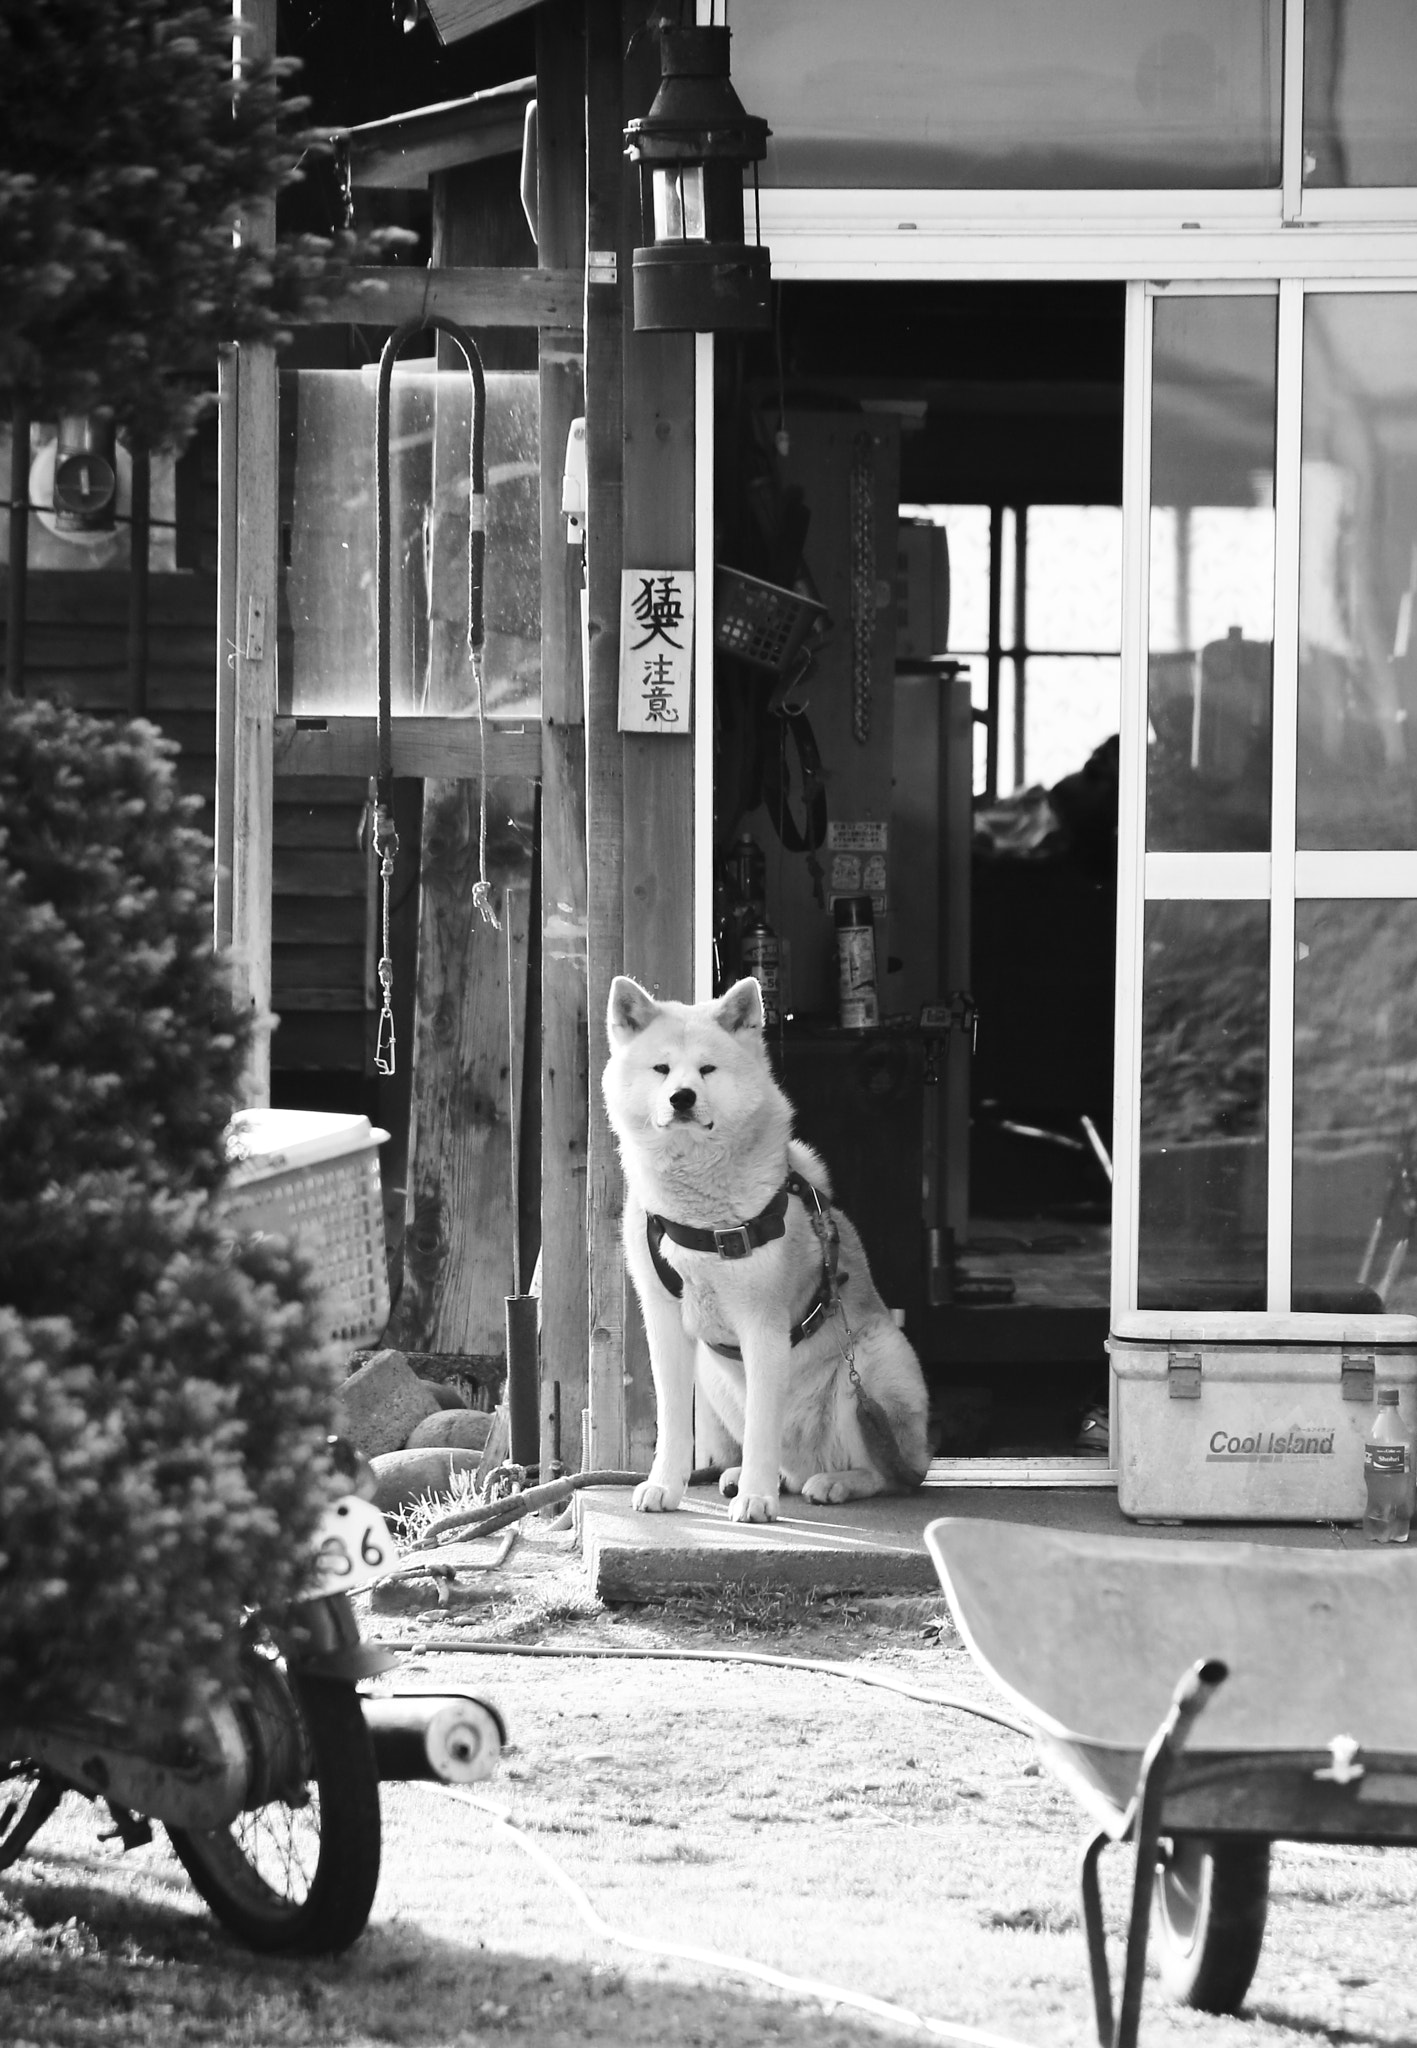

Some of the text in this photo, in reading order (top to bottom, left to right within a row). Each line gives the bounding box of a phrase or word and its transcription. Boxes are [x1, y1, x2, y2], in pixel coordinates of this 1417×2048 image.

[630, 576, 685, 722] 猛犬注意
[1209, 1431, 1335, 1454] Cool Island
